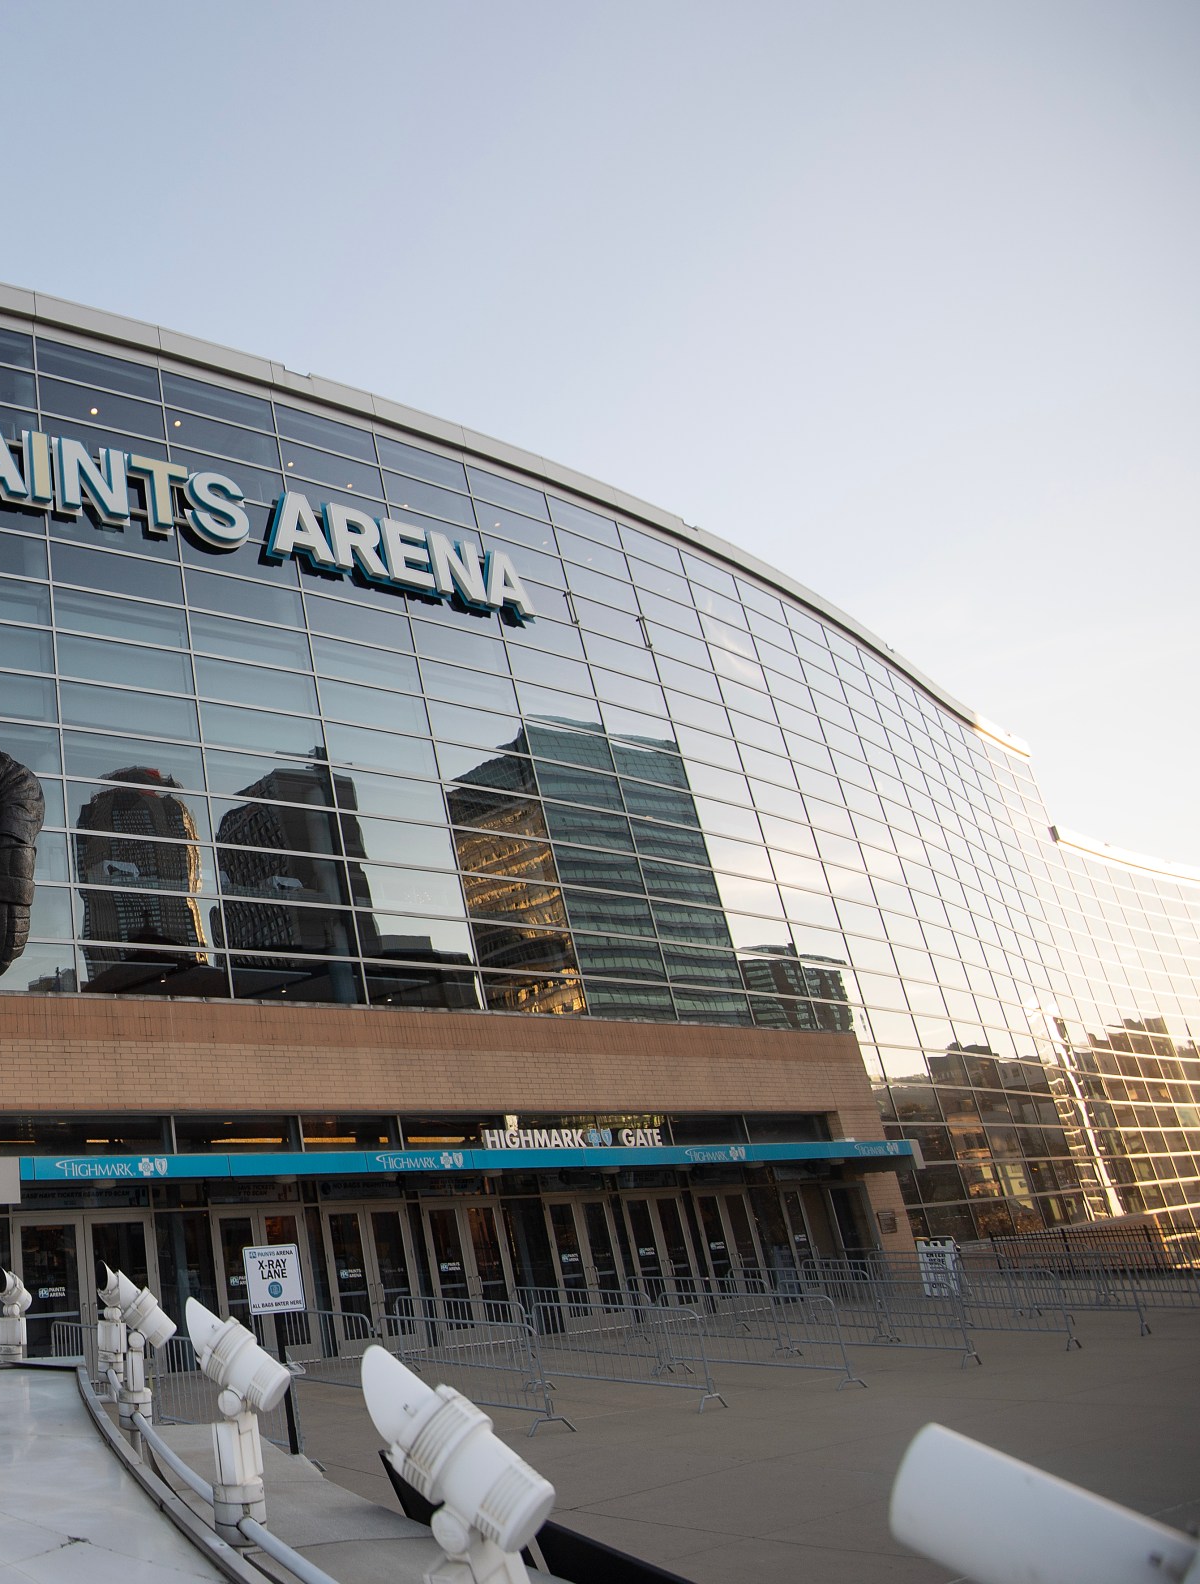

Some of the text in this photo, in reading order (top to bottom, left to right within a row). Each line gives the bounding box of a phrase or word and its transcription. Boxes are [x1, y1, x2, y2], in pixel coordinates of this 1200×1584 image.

[267, 490, 537, 622] ARENA
[482, 1128, 662, 1149] HIGHMARK GATE
[62, 1161, 134, 1177] HIGHMARK
[381, 1155, 438, 1170] HIGHMARK
[258, 1258, 287, 1270] X-RAY
[261, 1268, 287, 1280] LANE
